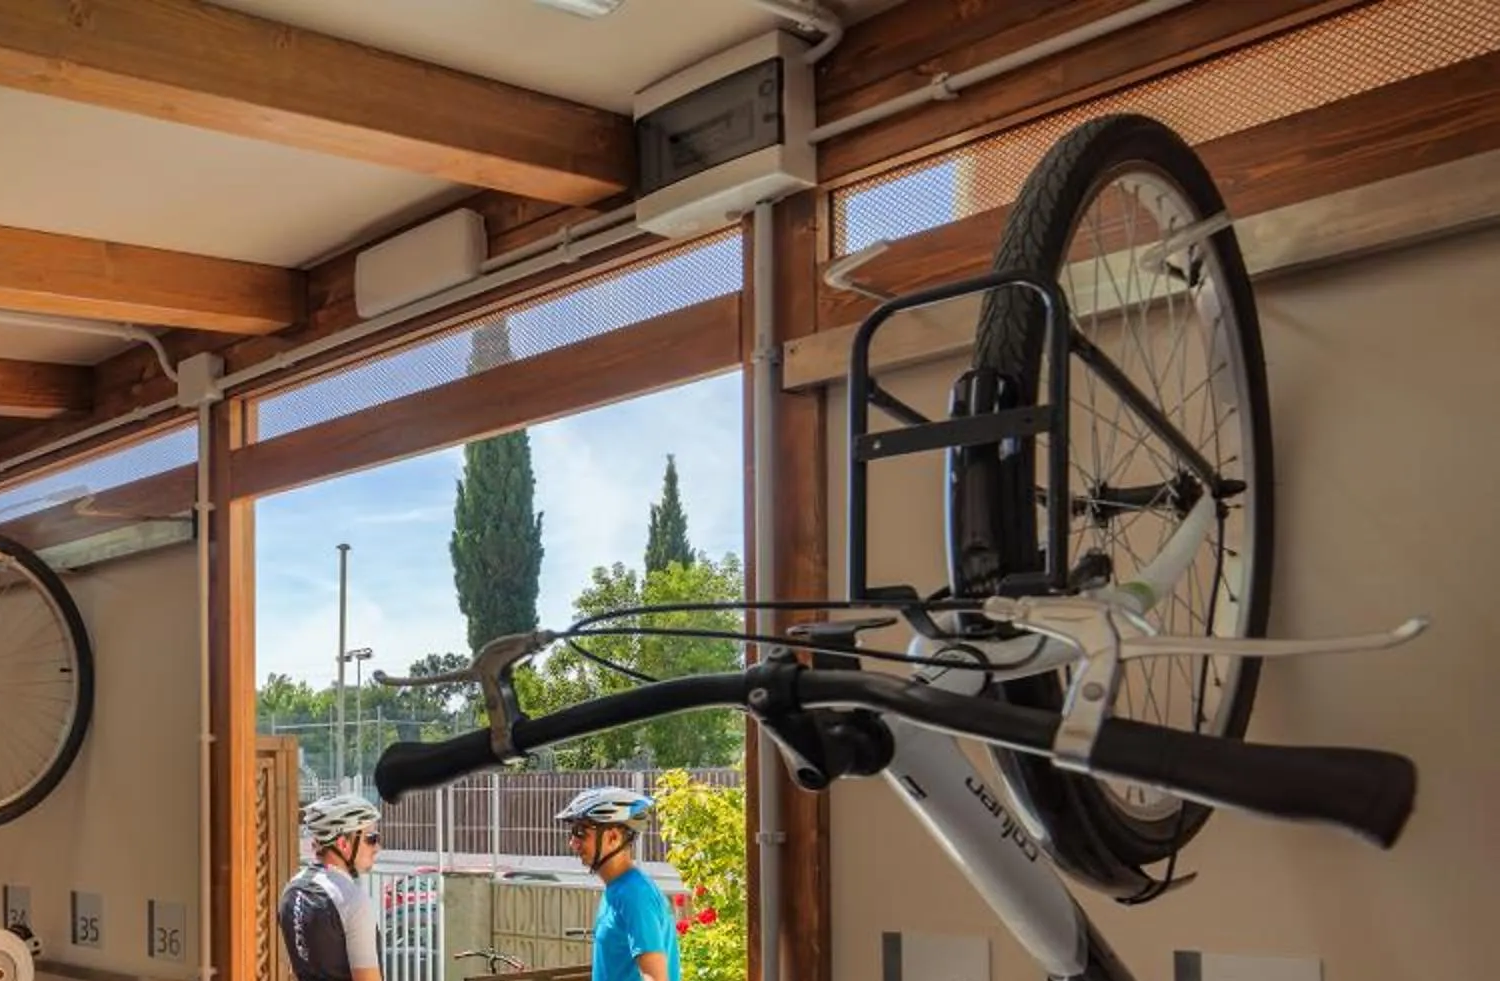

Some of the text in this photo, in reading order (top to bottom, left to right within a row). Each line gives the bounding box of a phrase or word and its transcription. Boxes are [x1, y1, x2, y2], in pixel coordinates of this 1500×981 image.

[964, 776, 1040, 863] coluer
[79, 916, 100, 943] 35
[156, 926, 181, 956] 36
